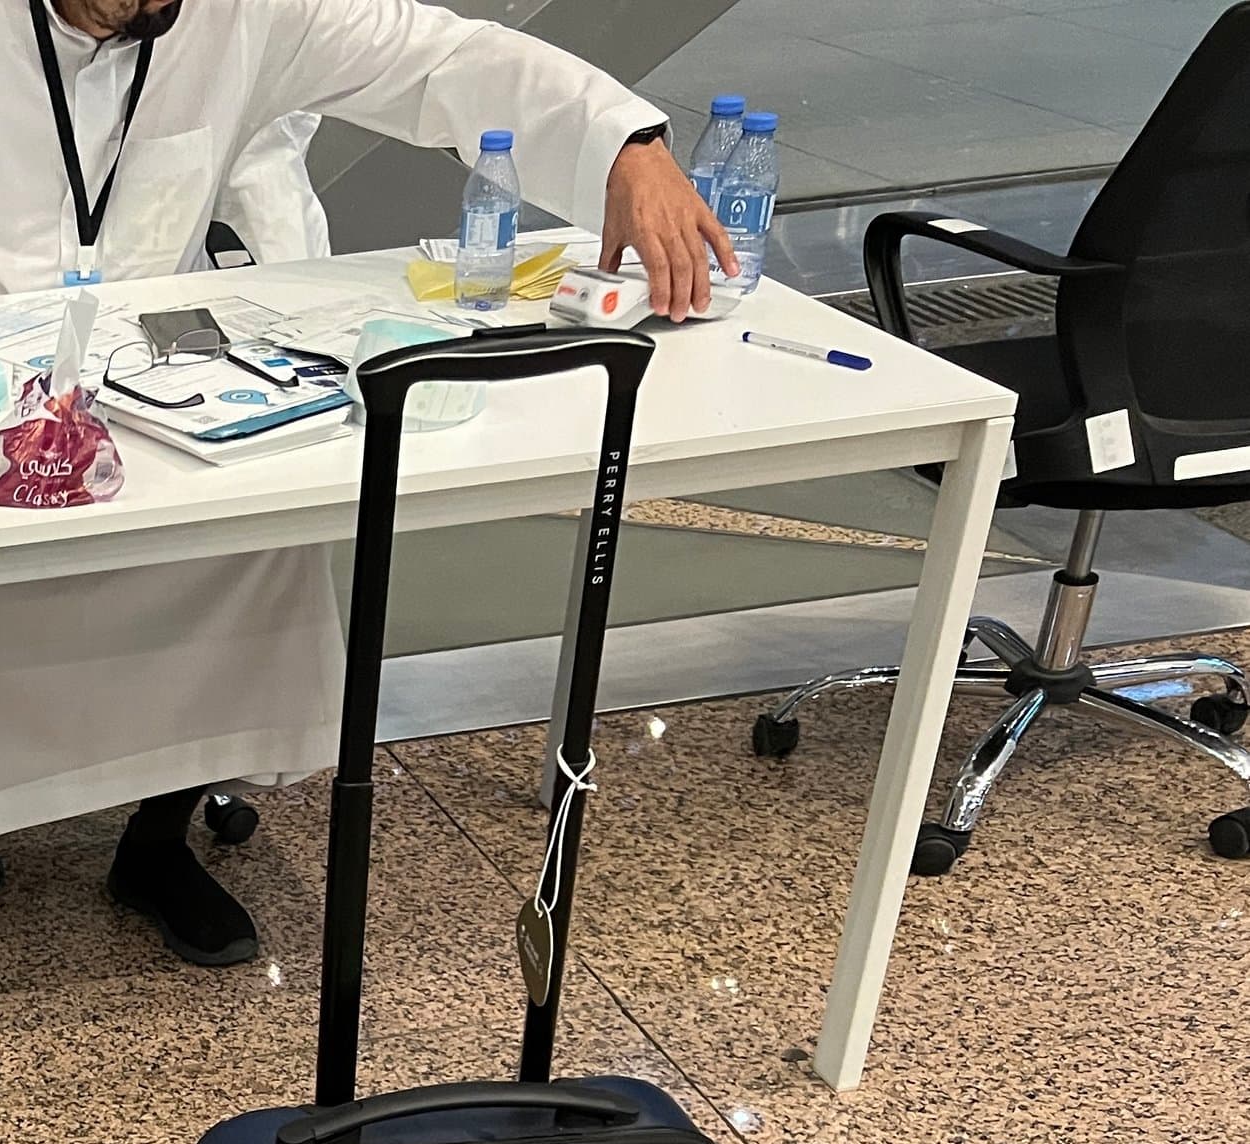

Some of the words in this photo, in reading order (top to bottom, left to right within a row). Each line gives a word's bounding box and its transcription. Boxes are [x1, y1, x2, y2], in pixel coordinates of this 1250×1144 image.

[19, 457, 73, 480] كلاسي
[601, 451, 620, 516] PERRY
[592, 527, 610, 584] ELLIS
